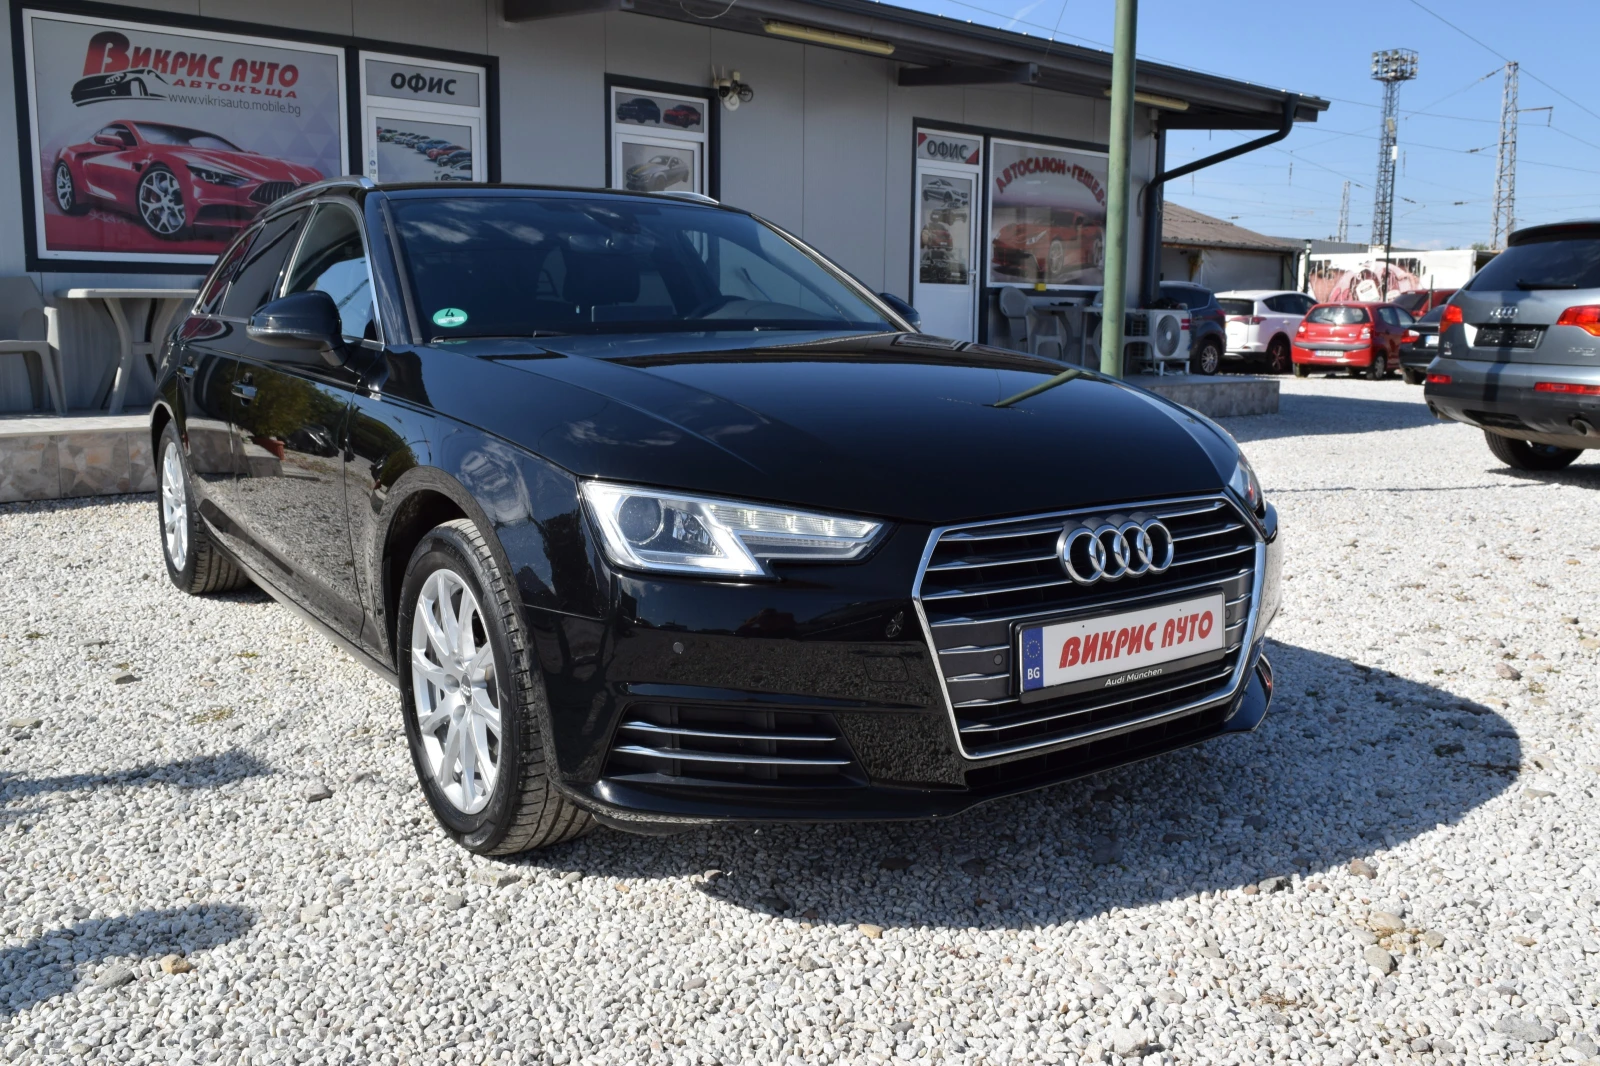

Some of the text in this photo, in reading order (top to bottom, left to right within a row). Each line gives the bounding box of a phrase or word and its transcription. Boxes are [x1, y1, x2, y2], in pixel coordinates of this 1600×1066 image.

[229, 58, 299, 88] АУТО
[390, 72, 457, 96] ОФИС
[172, 78, 298, 99] АВТОКЪЩА
[168, 93, 301, 117] www.vikrisauto.mobile.bg
[926, 139, 969, 160] ОФИС
[995, 156, 1105, 203] АВТОСАЛОН ГЕШЕВ
[445, 308, 455, 318] 4
[1058, 609, 1214, 669] ВИКРИС АУТО
[1027, 667, 1040, 680] BG
[1104, 667, 1163, 688] Audi München
